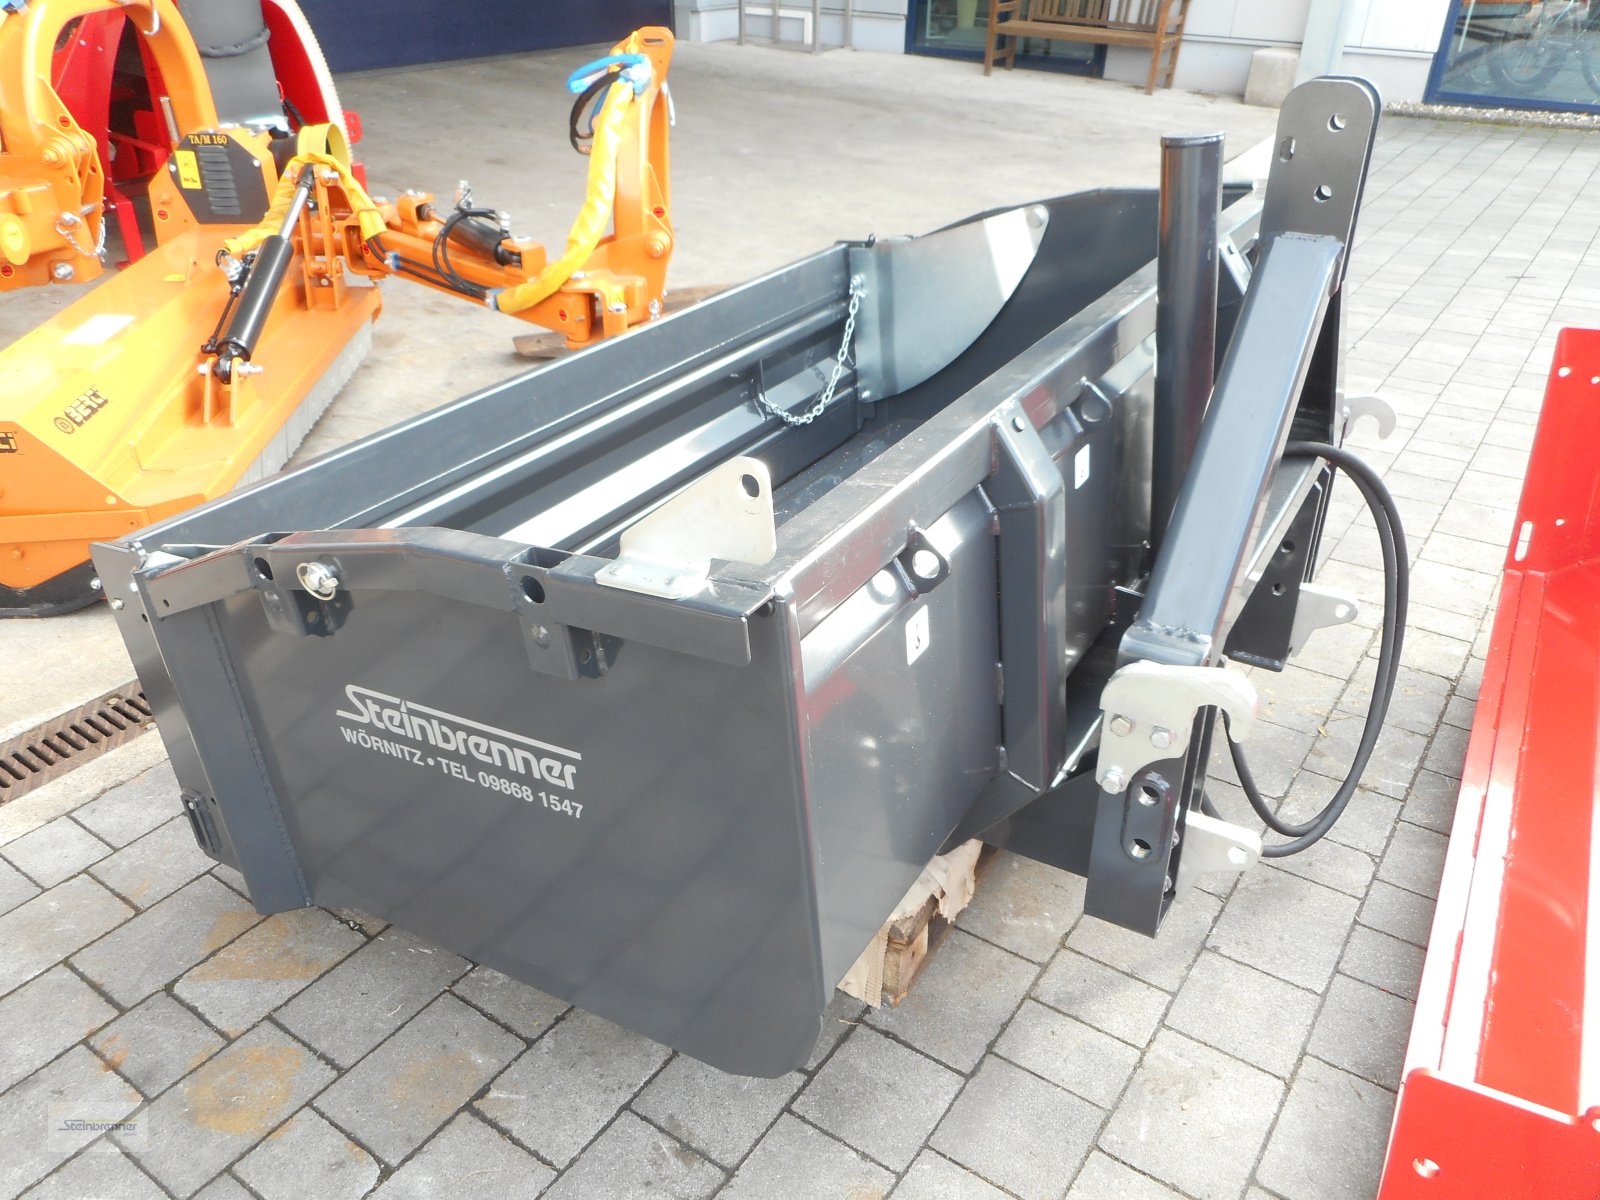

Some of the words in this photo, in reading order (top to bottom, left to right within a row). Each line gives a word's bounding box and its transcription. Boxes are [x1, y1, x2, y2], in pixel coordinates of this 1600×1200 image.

[189, 134, 211, 146] TA/M
[212, 134, 228, 145] 160
[336, 684, 583, 790] Steinbrenner
[340, 726, 425, 767] WÖRNITZ
[437, 757, 475, 783] TEL
[478, 771, 534, 802] 09868
[538, 791, 584, 819] 1547
